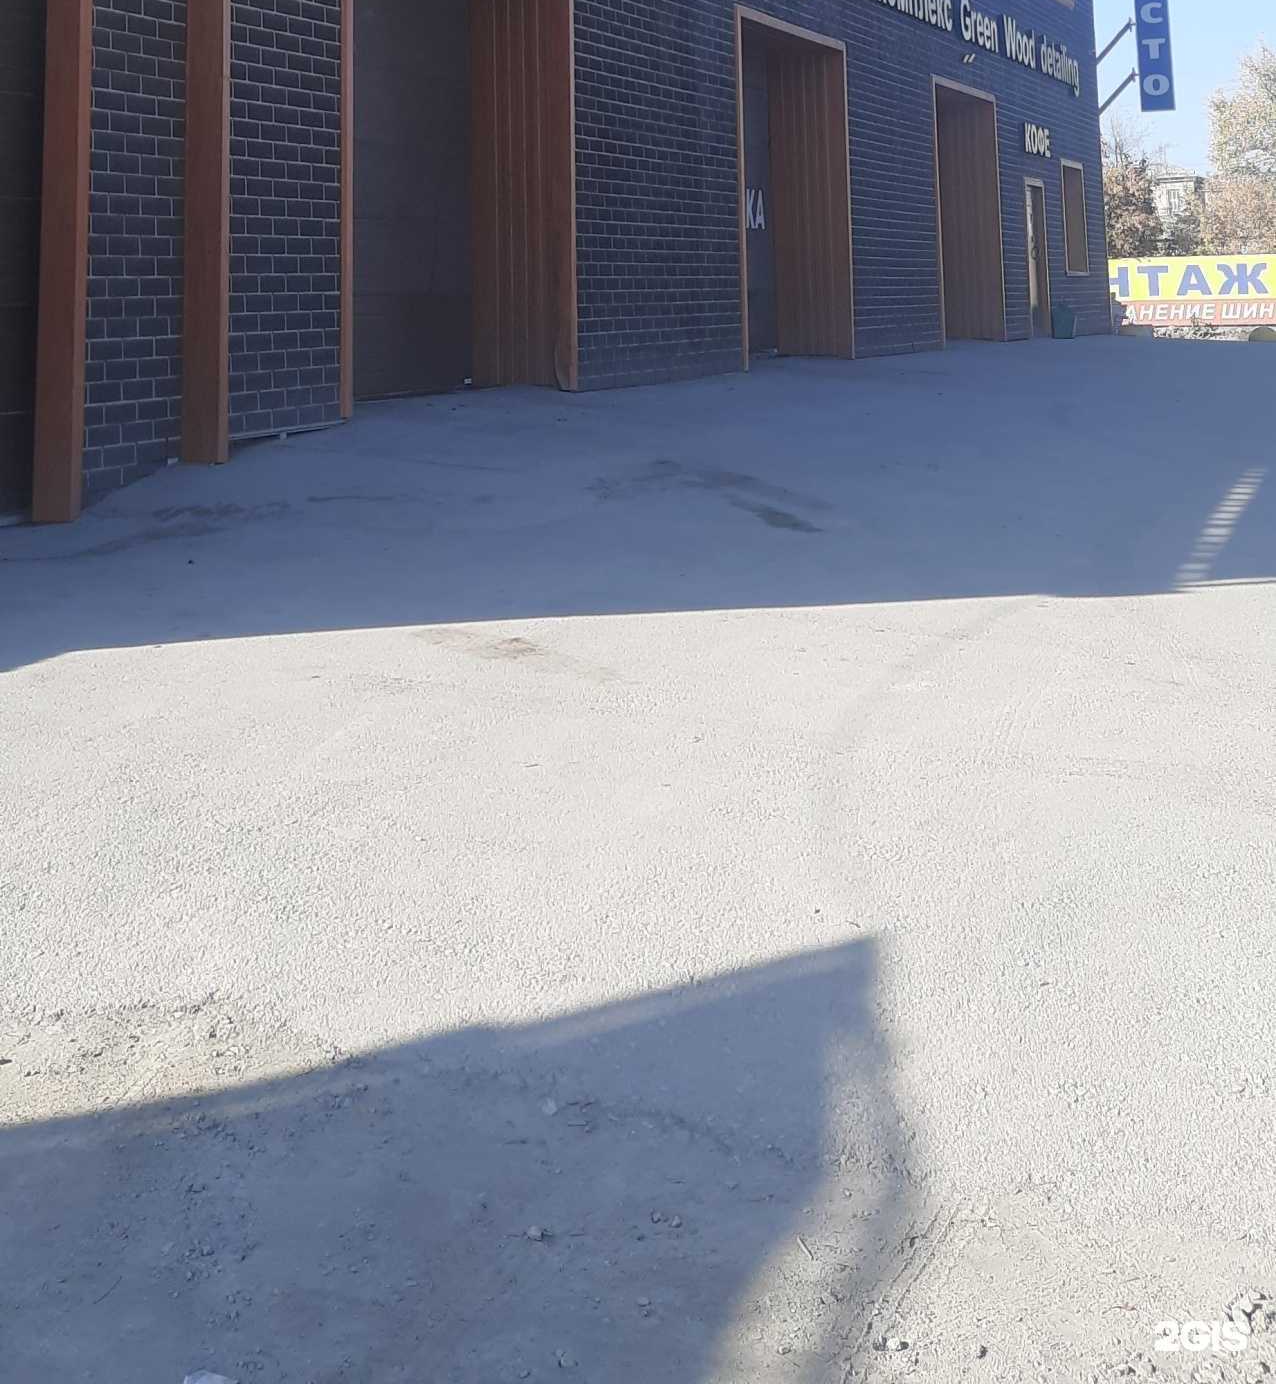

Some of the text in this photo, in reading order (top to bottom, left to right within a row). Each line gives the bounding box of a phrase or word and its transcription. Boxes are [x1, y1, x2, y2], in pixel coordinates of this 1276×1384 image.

[1003, 14, 1036, 70] Wood
[1040, 34, 1080, 98] detailing
[1140, 2, 1170, 97] СТО
[1024, 121, 1051, 158] КОФЕ
[1221, 303, 1274, 320] ШИН
